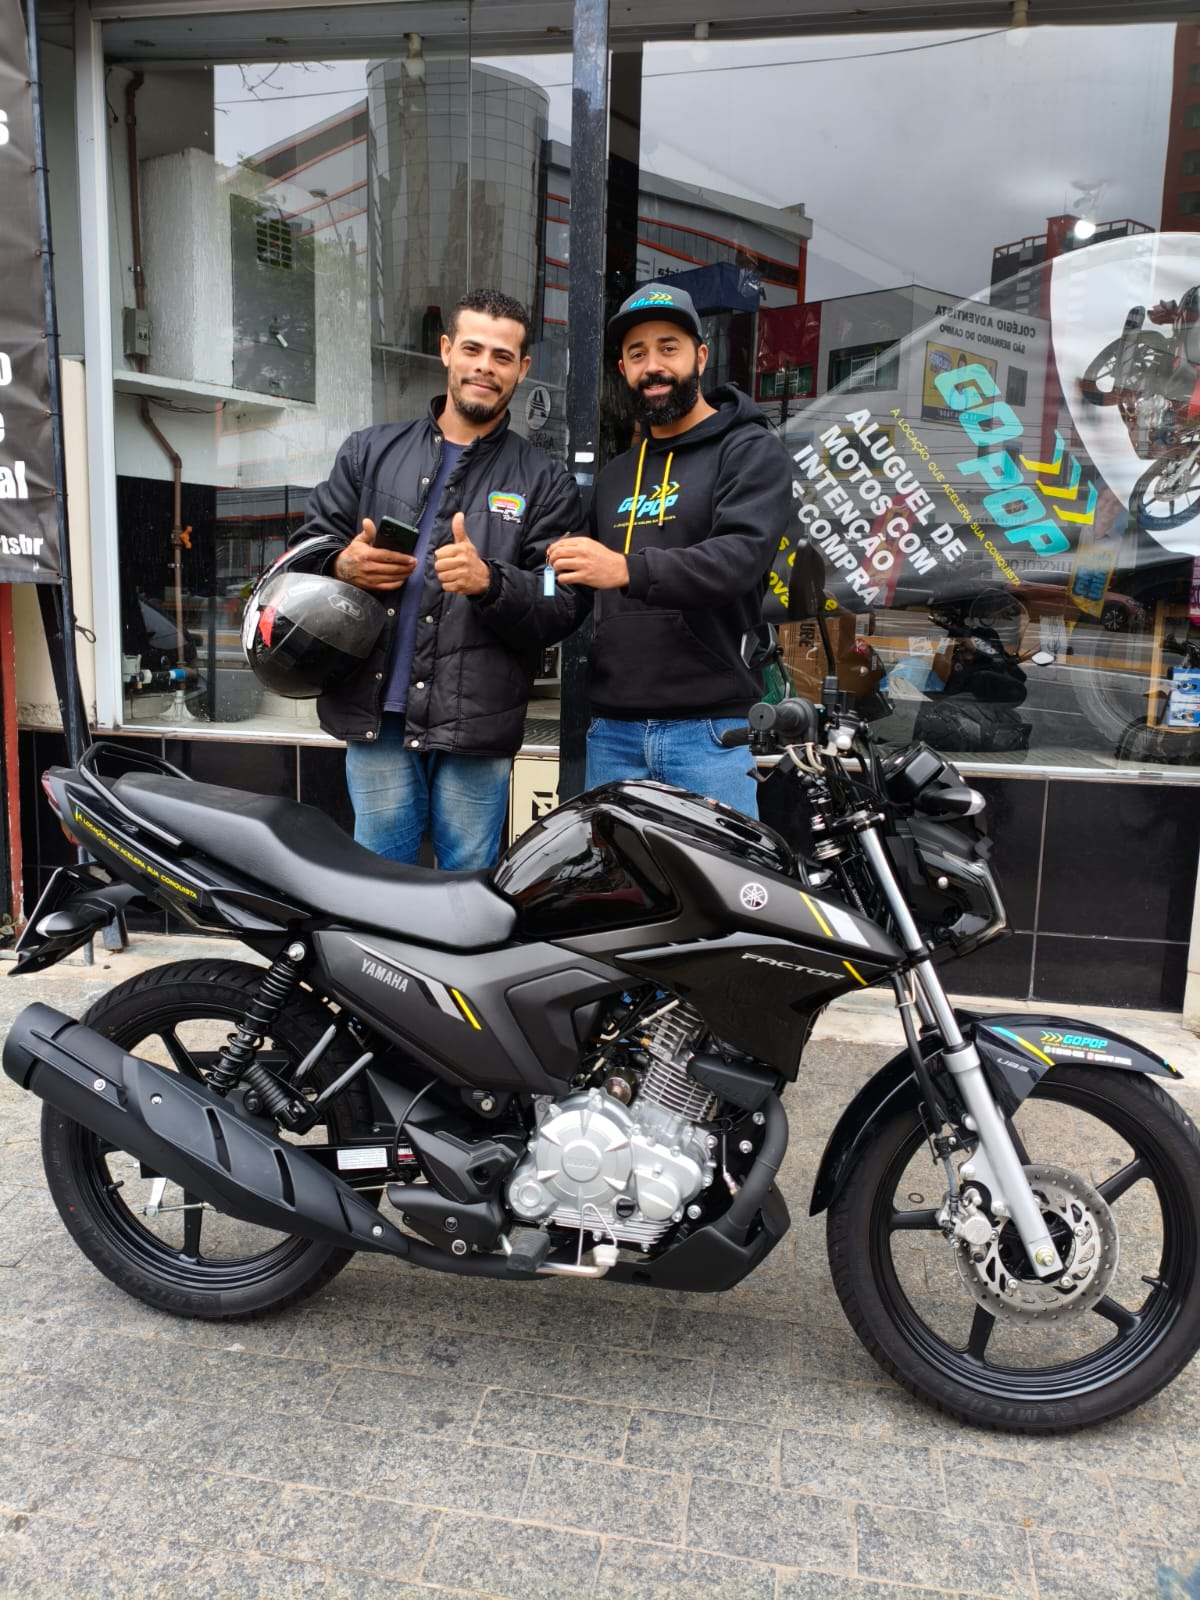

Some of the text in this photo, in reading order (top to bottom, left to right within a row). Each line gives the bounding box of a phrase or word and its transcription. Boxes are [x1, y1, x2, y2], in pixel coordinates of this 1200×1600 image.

[793, 445, 894, 571] INTENÇÃO
[819, 425, 938, 575] MOTOS COM
[845, 408, 968, 563] ALUGUEL DE
[890, 408, 901, 418] A
[898, 418, 930, 461] LOCAÇÃO
[928, 461, 945, 482] QUE
[941, 483, 972, 522] ACELERA
[970, 522, 985, 541] SUA
[984, 540, 1021, 587] CONQUISTA
[798, 504, 880, 606] COMPRA
[160, 875, 198, 900] CONQUISTA
[361, 958, 409, 993] YAMAHA
[741, 952, 846, 980] FACTOR
[1062, 1034, 1109, 1048] GOPOP
